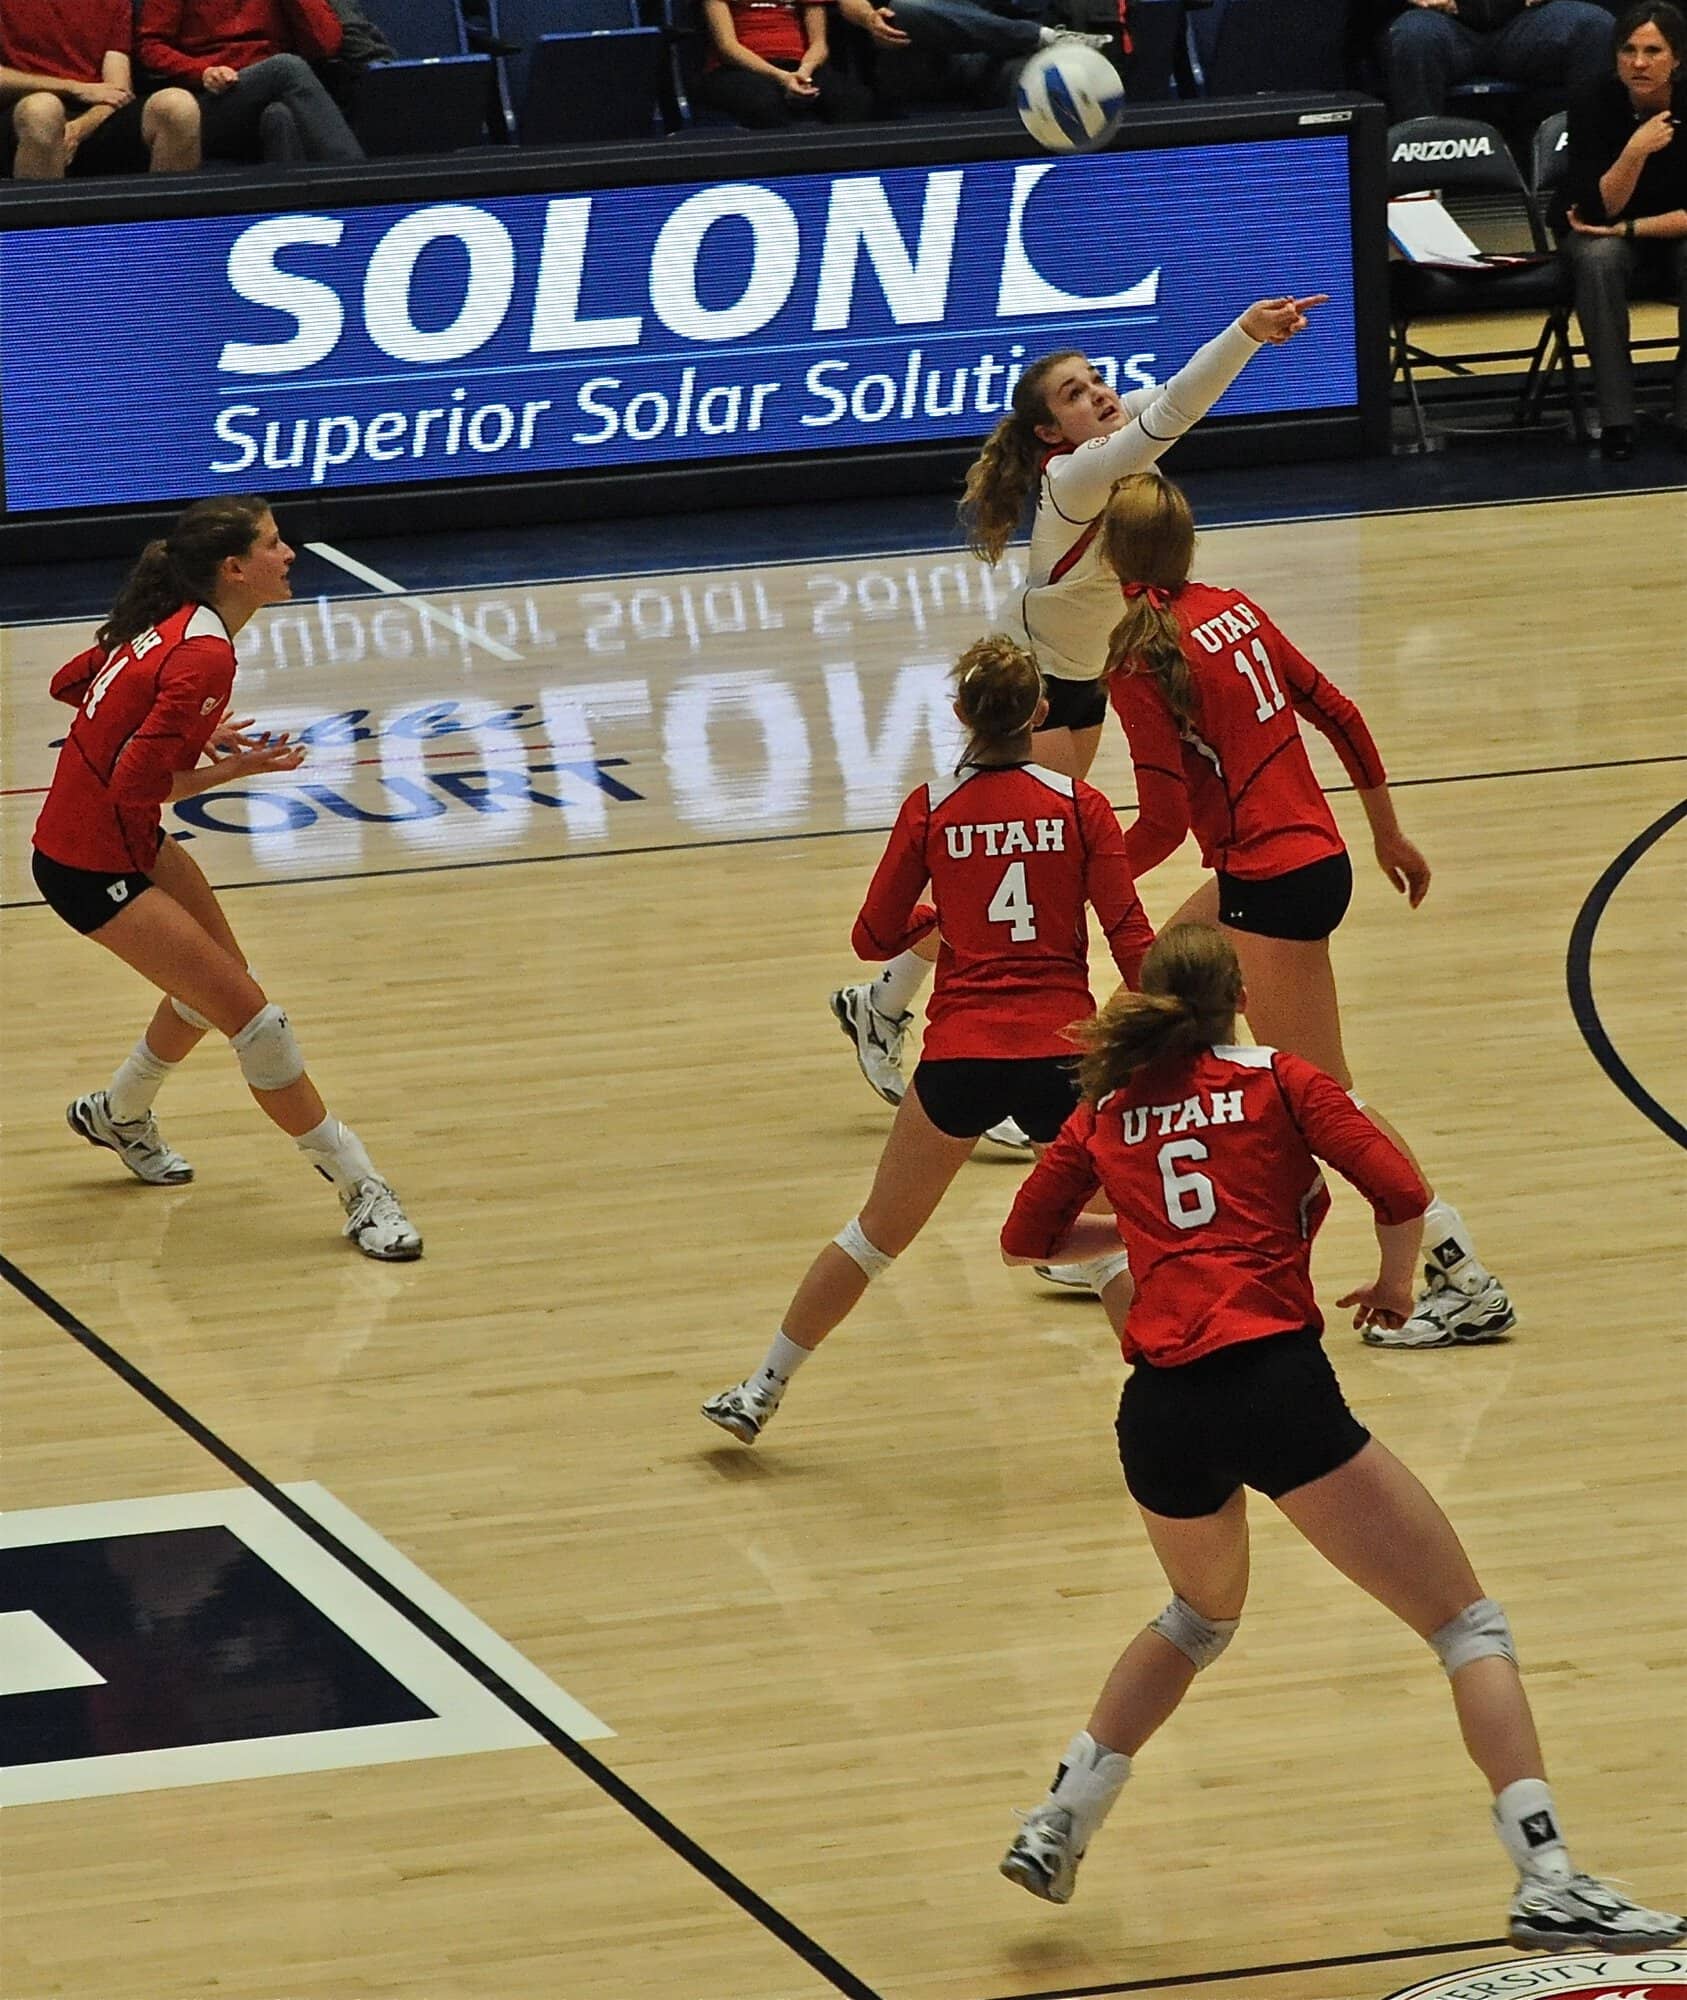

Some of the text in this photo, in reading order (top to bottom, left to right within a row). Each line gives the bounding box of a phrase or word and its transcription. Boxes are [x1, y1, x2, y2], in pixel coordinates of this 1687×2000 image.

[1391, 136, 1494, 162] ARIZONA
[217, 168, 963, 376] SOLON
[210, 344, 1157, 484] Superior Solar Solutins
[1190, 603, 1260, 653] UTAH
[1233, 638, 1286, 722] 11
[172, 757, 646, 842] OURT
[944, 819, 1065, 858] UTAH
[106, 880, 128, 902] U
[988, 862, 1036, 942] 4
[1122, 1090, 1245, 1145] UTAH
[1157, 1138, 1216, 1230] 6
[1435, 1959, 1687, 2000] ERSITY O
